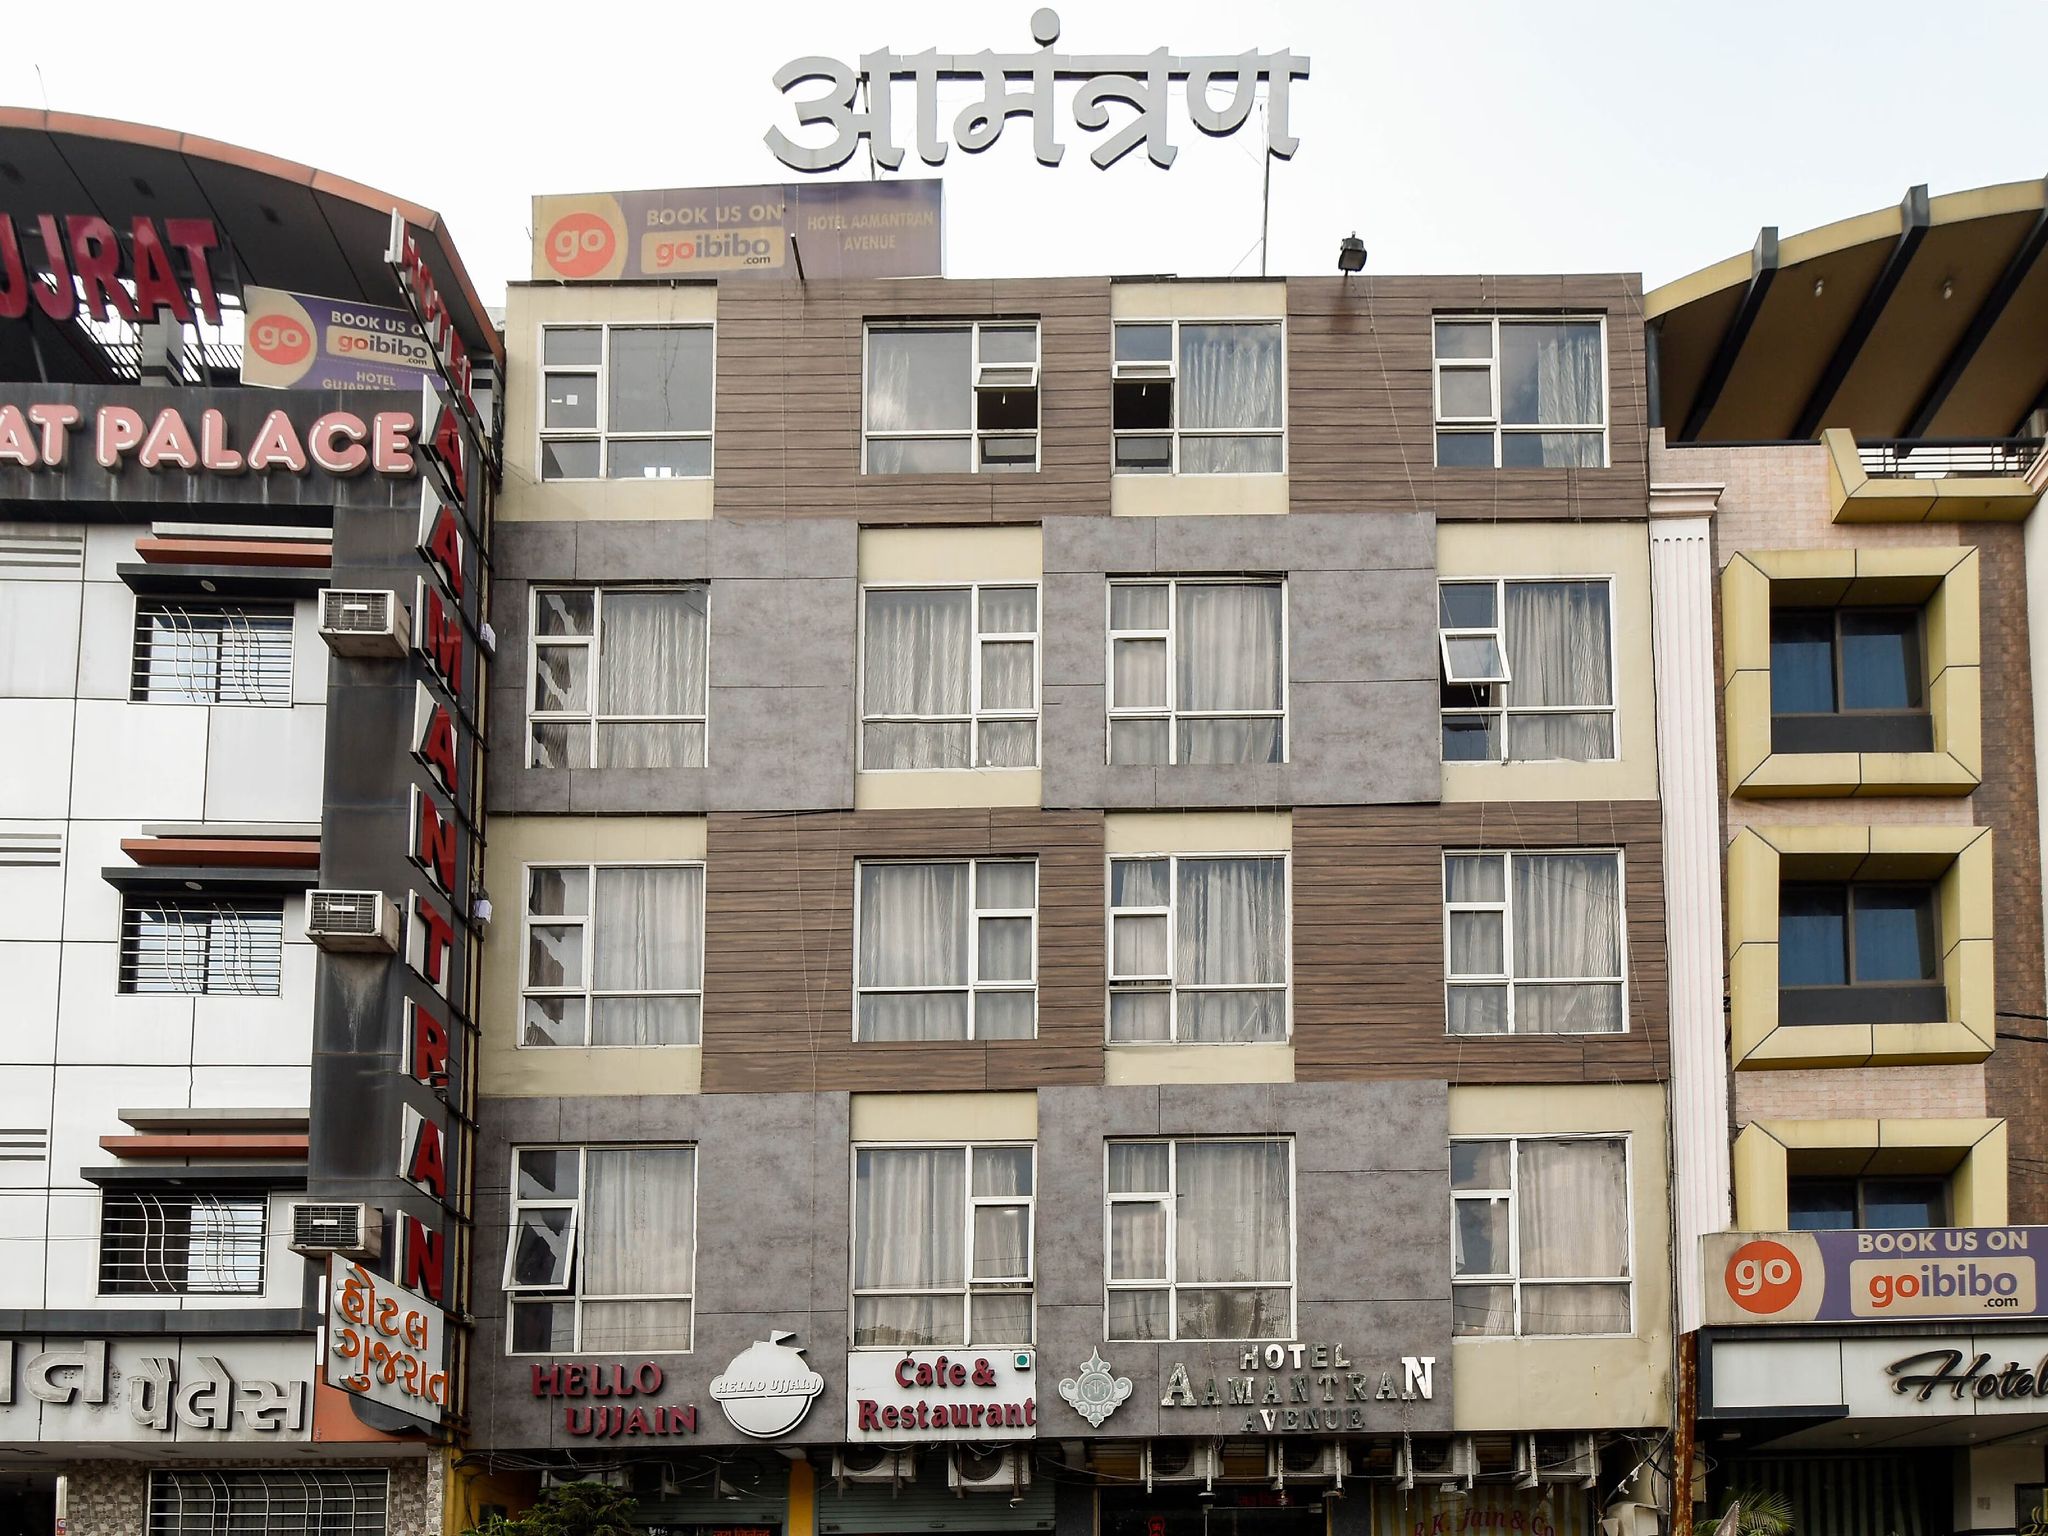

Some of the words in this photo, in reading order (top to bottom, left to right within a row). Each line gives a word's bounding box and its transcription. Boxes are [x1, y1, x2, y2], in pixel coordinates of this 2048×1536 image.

[763, 7, 1310, 171] आमंत्रण
[647, 207, 708, 226] BOOK
[717, 205, 742, 223] US
[749, 204, 784, 222] ON
[808, 214, 847, 229] HOTEL
[850, 211, 933, 228] AAMANTRAN
[556, 228, 606, 263] go
[656, 233, 770, 267] goibibo
[844, 235, 896, 251] AVENUE
[257, 325, 303, 351] go
[331, 310, 380, 330] BOOK
[385, 319, 406, 332] US
[411, 324, 424, 336] O
[338, 334, 428, 359] goibibo
[356, 371, 397, 386] HOTEL
[96, 406, 415, 477] PALACE
[1858, 1233, 1936, 1253] BOOK
[1945, 1233, 1978, 1251] US
[1987, 1231, 2028, 1250] ON
[1735, 1258, 1792, 1296] go
[1869, 1264, 2018, 1308] goibibo
[333, 1263, 428, 1351] હોટલ
[332, 1328, 448, 1406] ગુજરાત
[895, 1355, 966, 1388] Cafe
[972, 1358, 997, 1387] &
[1239, 1343, 1350, 1370] HOTEL
[530, 1361, 664, 1397] HELLO
[716, 1381, 766, 1393] HELLO
[1161, 1356, 1436, 1407] AAMANTRAN
[1885, 1349, 2048, 1402] Hotel
[564, 1404, 697, 1439] UJJAIN
[857, 1398, 1037, 1431] Restaurant
[1240, 1407, 1365, 1432] AVENUE
[1457, 1507, 1506, 1532] Jain
[1511, 1510, 1526, 1530] &
